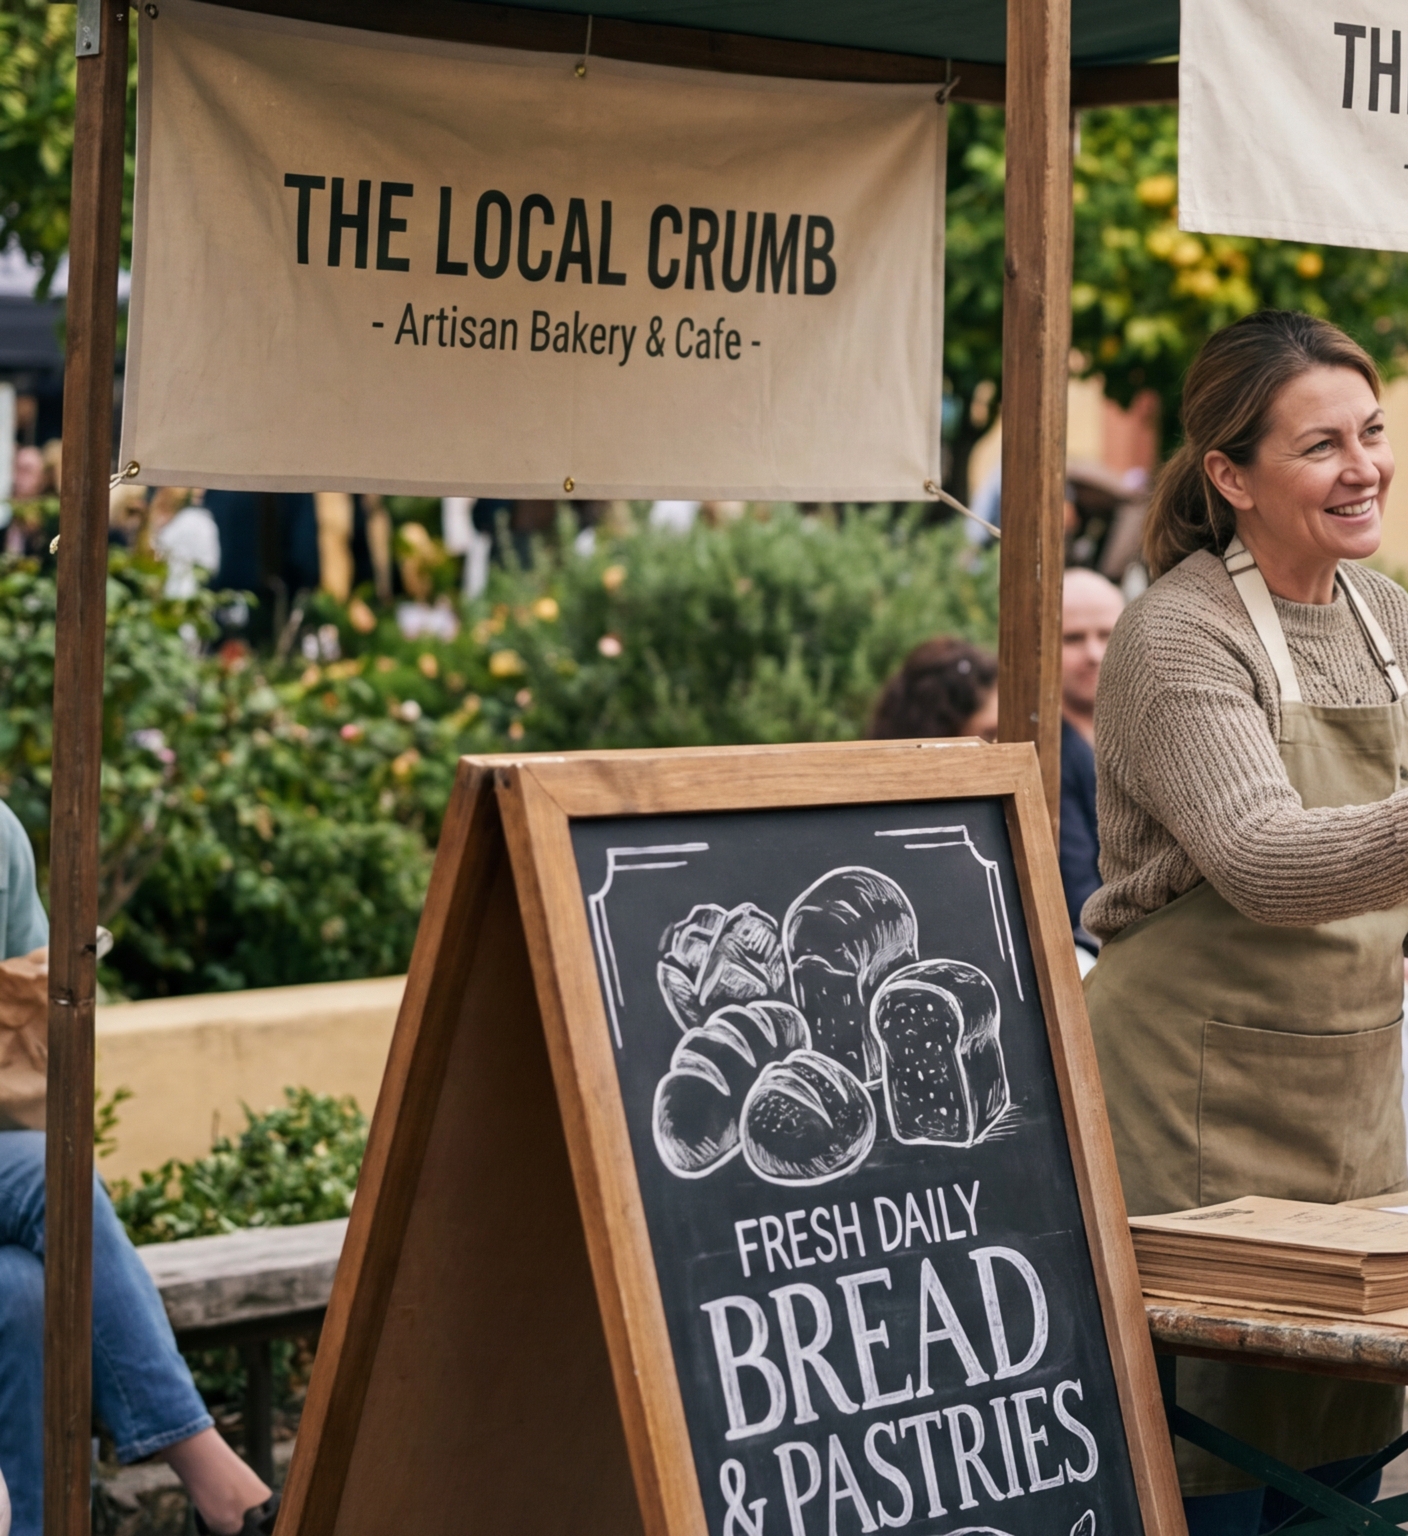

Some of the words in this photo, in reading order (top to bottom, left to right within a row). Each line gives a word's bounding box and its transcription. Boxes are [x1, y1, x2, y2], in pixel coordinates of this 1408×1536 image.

[283, 172, 414, 273] THE
[435, 186, 627, 287] LOCAL
[647, 203, 838, 297] CRUMB
[394, 302, 518, 351] Artisan
[530, 309, 638, 367] Bakery
[645, 315, 666, 358] &
[675, 316, 742, 361] Cafe
[734, 1201, 867, 1278] FRESH
[873, 1179, 980, 1253] DAILY
[699, 1245, 1049, 1442] BREAD
[719, 1458, 768, 1536] &
[772, 1378, 1099, 1536] PASTRIES
